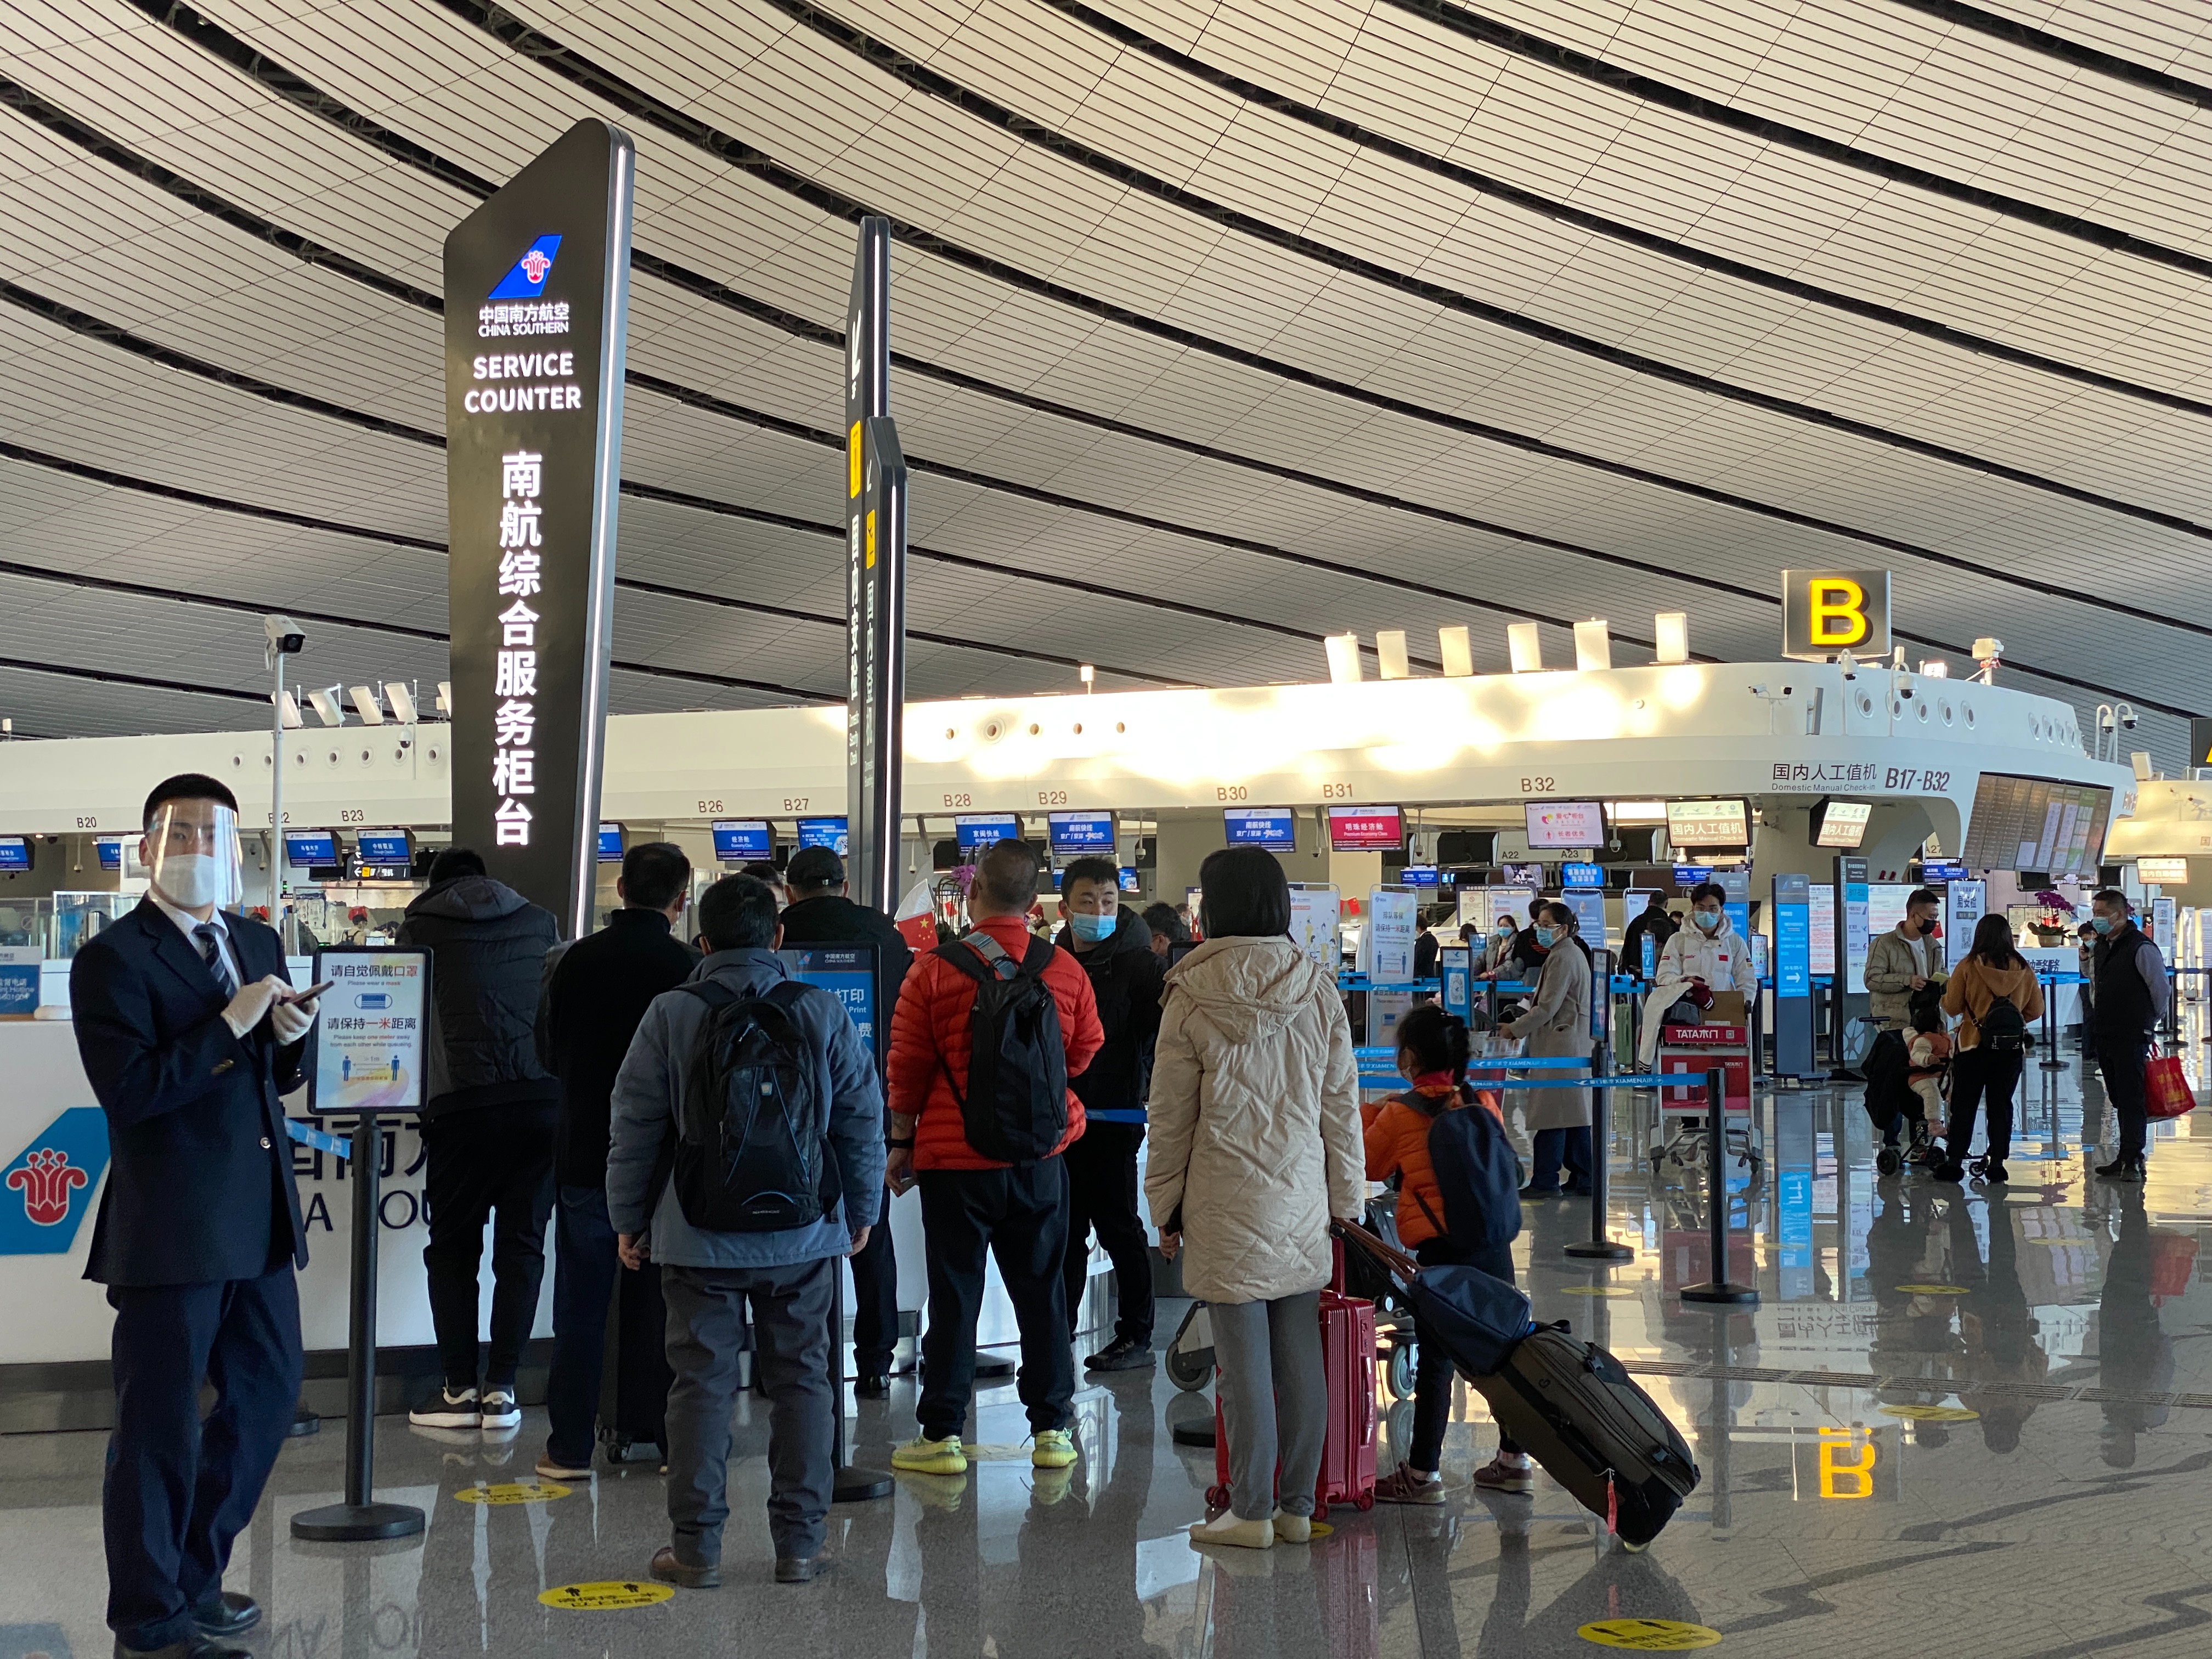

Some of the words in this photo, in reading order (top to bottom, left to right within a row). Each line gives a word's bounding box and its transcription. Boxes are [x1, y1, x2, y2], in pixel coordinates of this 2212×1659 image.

[478, 303, 569, 323] 中国南方航空
[478, 325, 510, 337] CHINA
[513, 321, 568, 335] SOUTHERN
[472, 352, 574, 380] SERVICE
[464, 386, 582, 413] COUNTER
[1810, 579, 1866, 645] B
[492, 450, 543, 846] 南航综合服务柜台
[1773, 763, 1877, 781] 国内人工值机
[1521, 777, 1555, 792] B32
[1885, 767, 1951, 792] B17-B32
[1216, 786, 1248, 801] B30
[1323, 783, 1354, 798] B31
[1771, 783, 1812, 792] Domestic
[1843, 783, 1876, 791] Check-in
[783, 798, 810, 811] B27
[943, 793, 972, 808] B28
[1039, 791, 1068, 805] B29
[698, 800, 724, 813] B26
[77, 816, 97, 828] B20
[341, 810, 364, 822] B23
[1672, 822, 1743, 836] 国内人工值机
[1821, 824, 1863, 838] 国内人工值机
[1502, 851, 1519, 859] A22
[1561, 850, 1579, 859] A23
[331, 964, 418, 978] 请自觉佩戴口罩
[328, 1017, 416, 1030] 请保持一米距离
